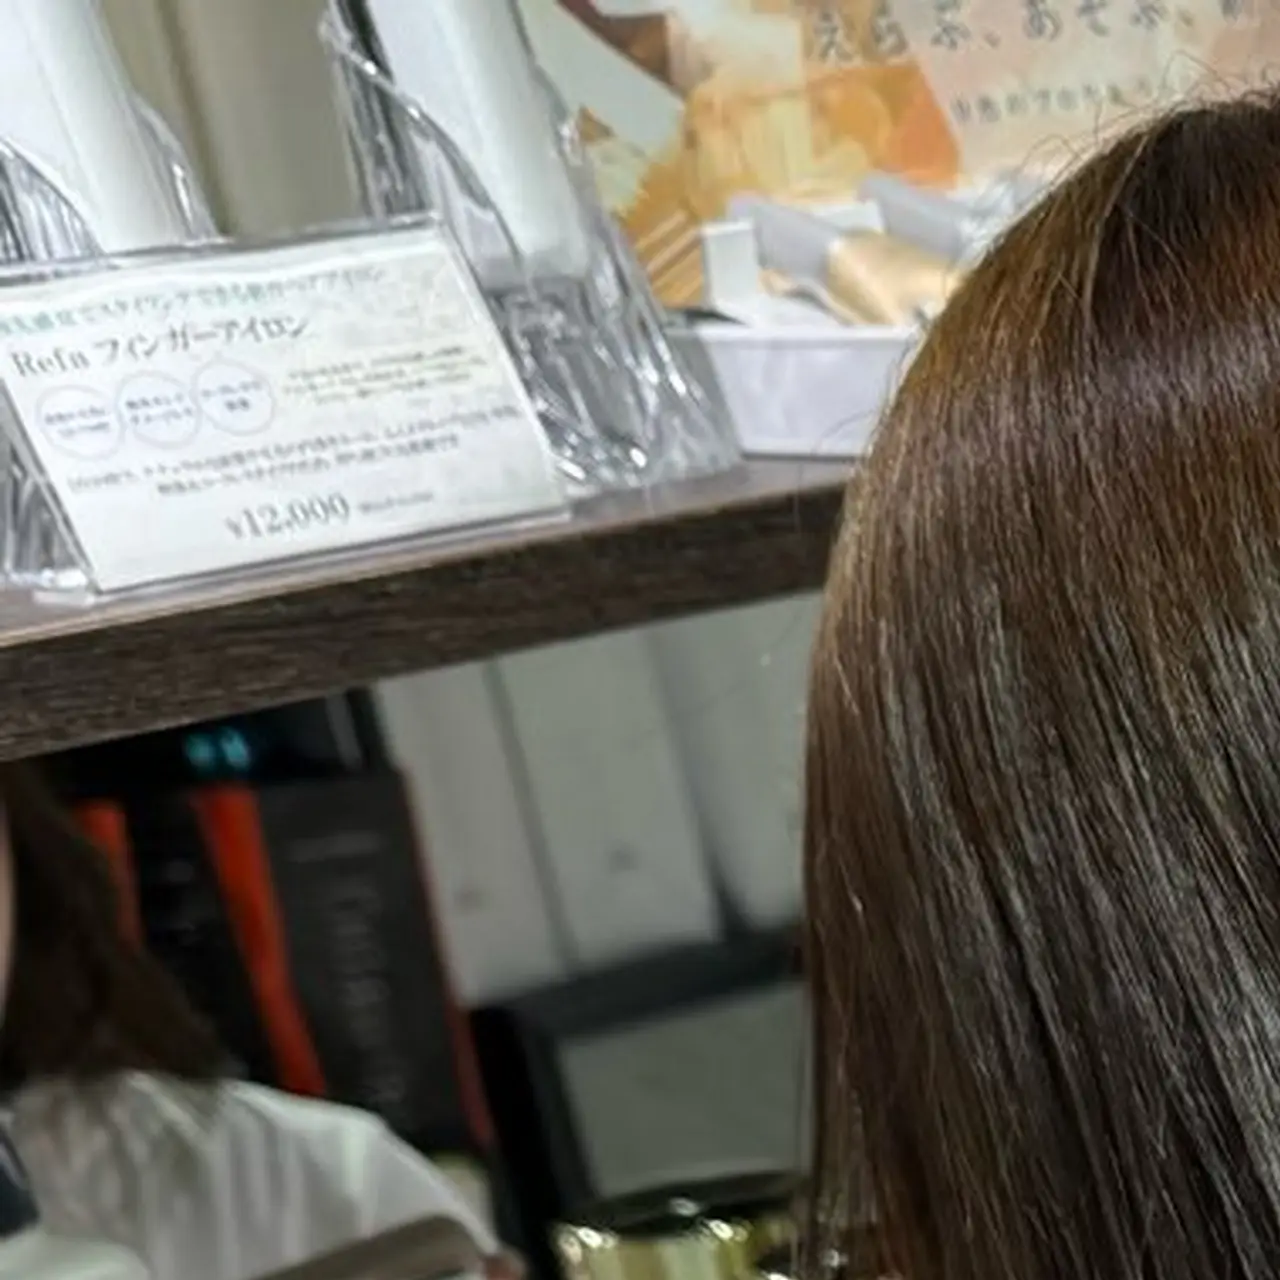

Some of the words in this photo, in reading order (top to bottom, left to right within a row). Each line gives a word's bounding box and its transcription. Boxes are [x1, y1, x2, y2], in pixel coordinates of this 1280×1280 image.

[95, 315, 309, 360] フィンガーアイロン
